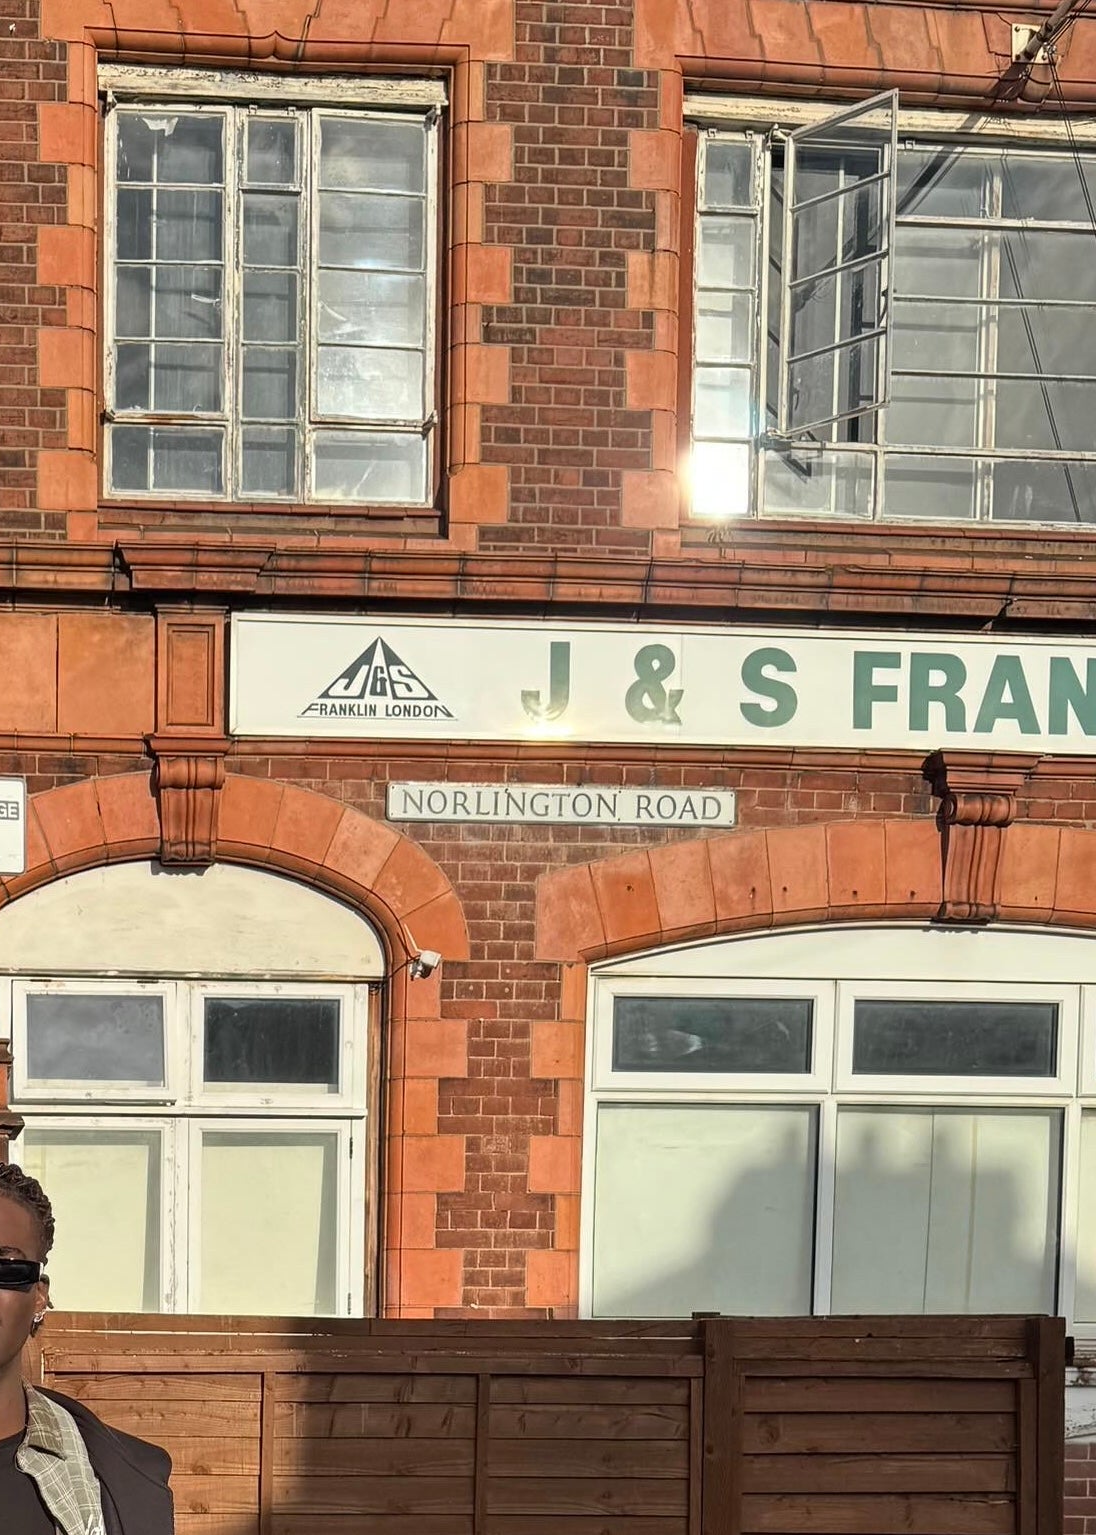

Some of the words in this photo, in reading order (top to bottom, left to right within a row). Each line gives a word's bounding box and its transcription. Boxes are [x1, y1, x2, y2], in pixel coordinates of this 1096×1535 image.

[521, 641, 570, 722] J
[625, 644, 685, 726] &
[740, 647, 798, 728] S
[853, 650, 1096, 736] FRAN
[301, 702, 377, 717] FRANKLIN
[385, 704, 454, 718] LONDON
[402, 789, 618, 818] NORLINGTON
[636, 794, 722, 820] ROAD
